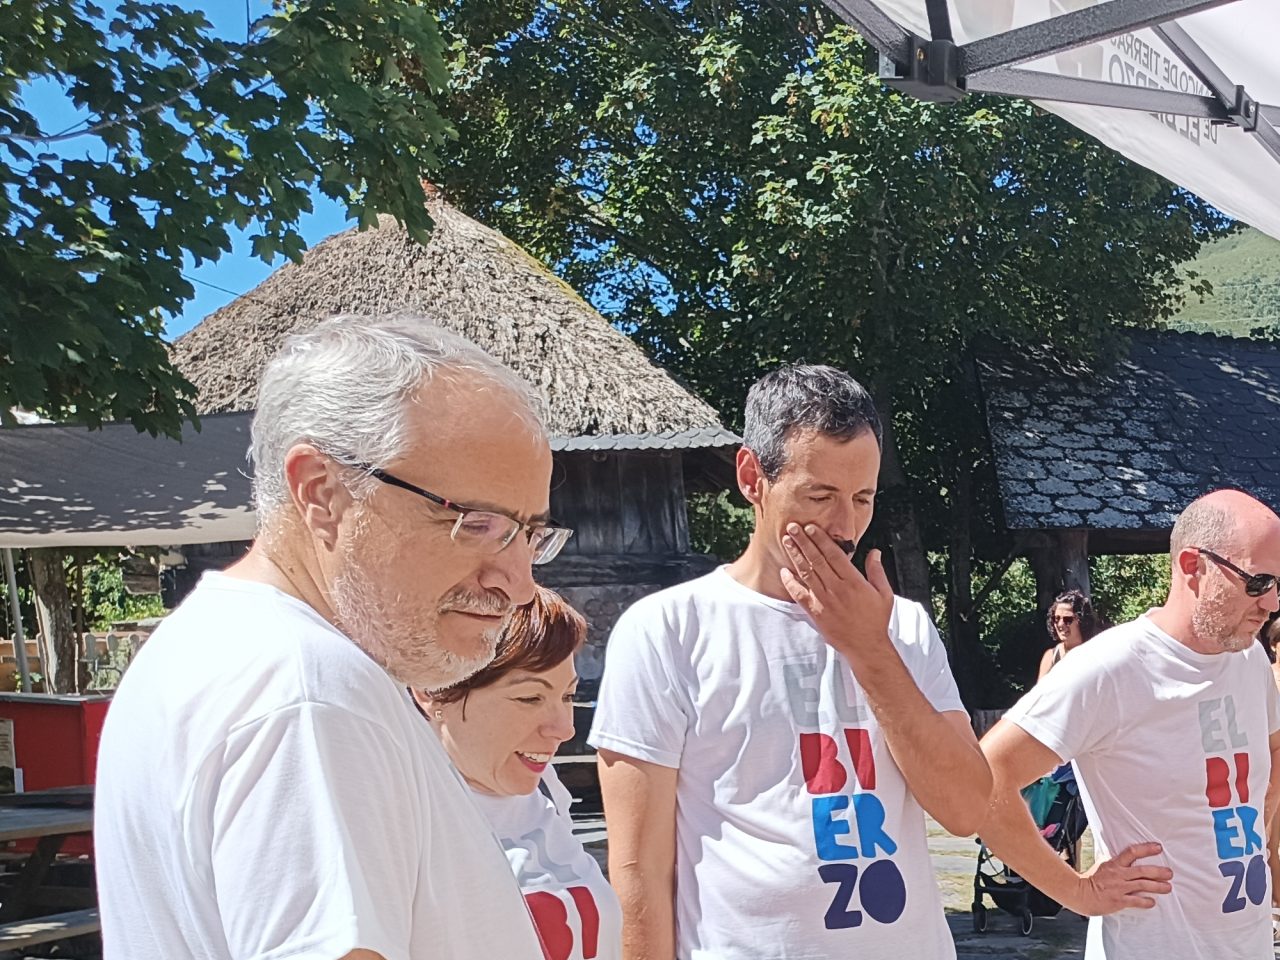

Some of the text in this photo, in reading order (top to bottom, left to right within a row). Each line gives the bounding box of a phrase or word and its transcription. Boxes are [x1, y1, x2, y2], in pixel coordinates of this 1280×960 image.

[1199, 695, 1249, 753] EL
[799, 728, 876, 795] BI
[1206, 753, 1250, 808] BI
[812, 793, 898, 861] ER
[1212, 805, 1262, 860] ER
[818, 858, 907, 930] ZO
[1218, 855, 1267, 914] ZO
